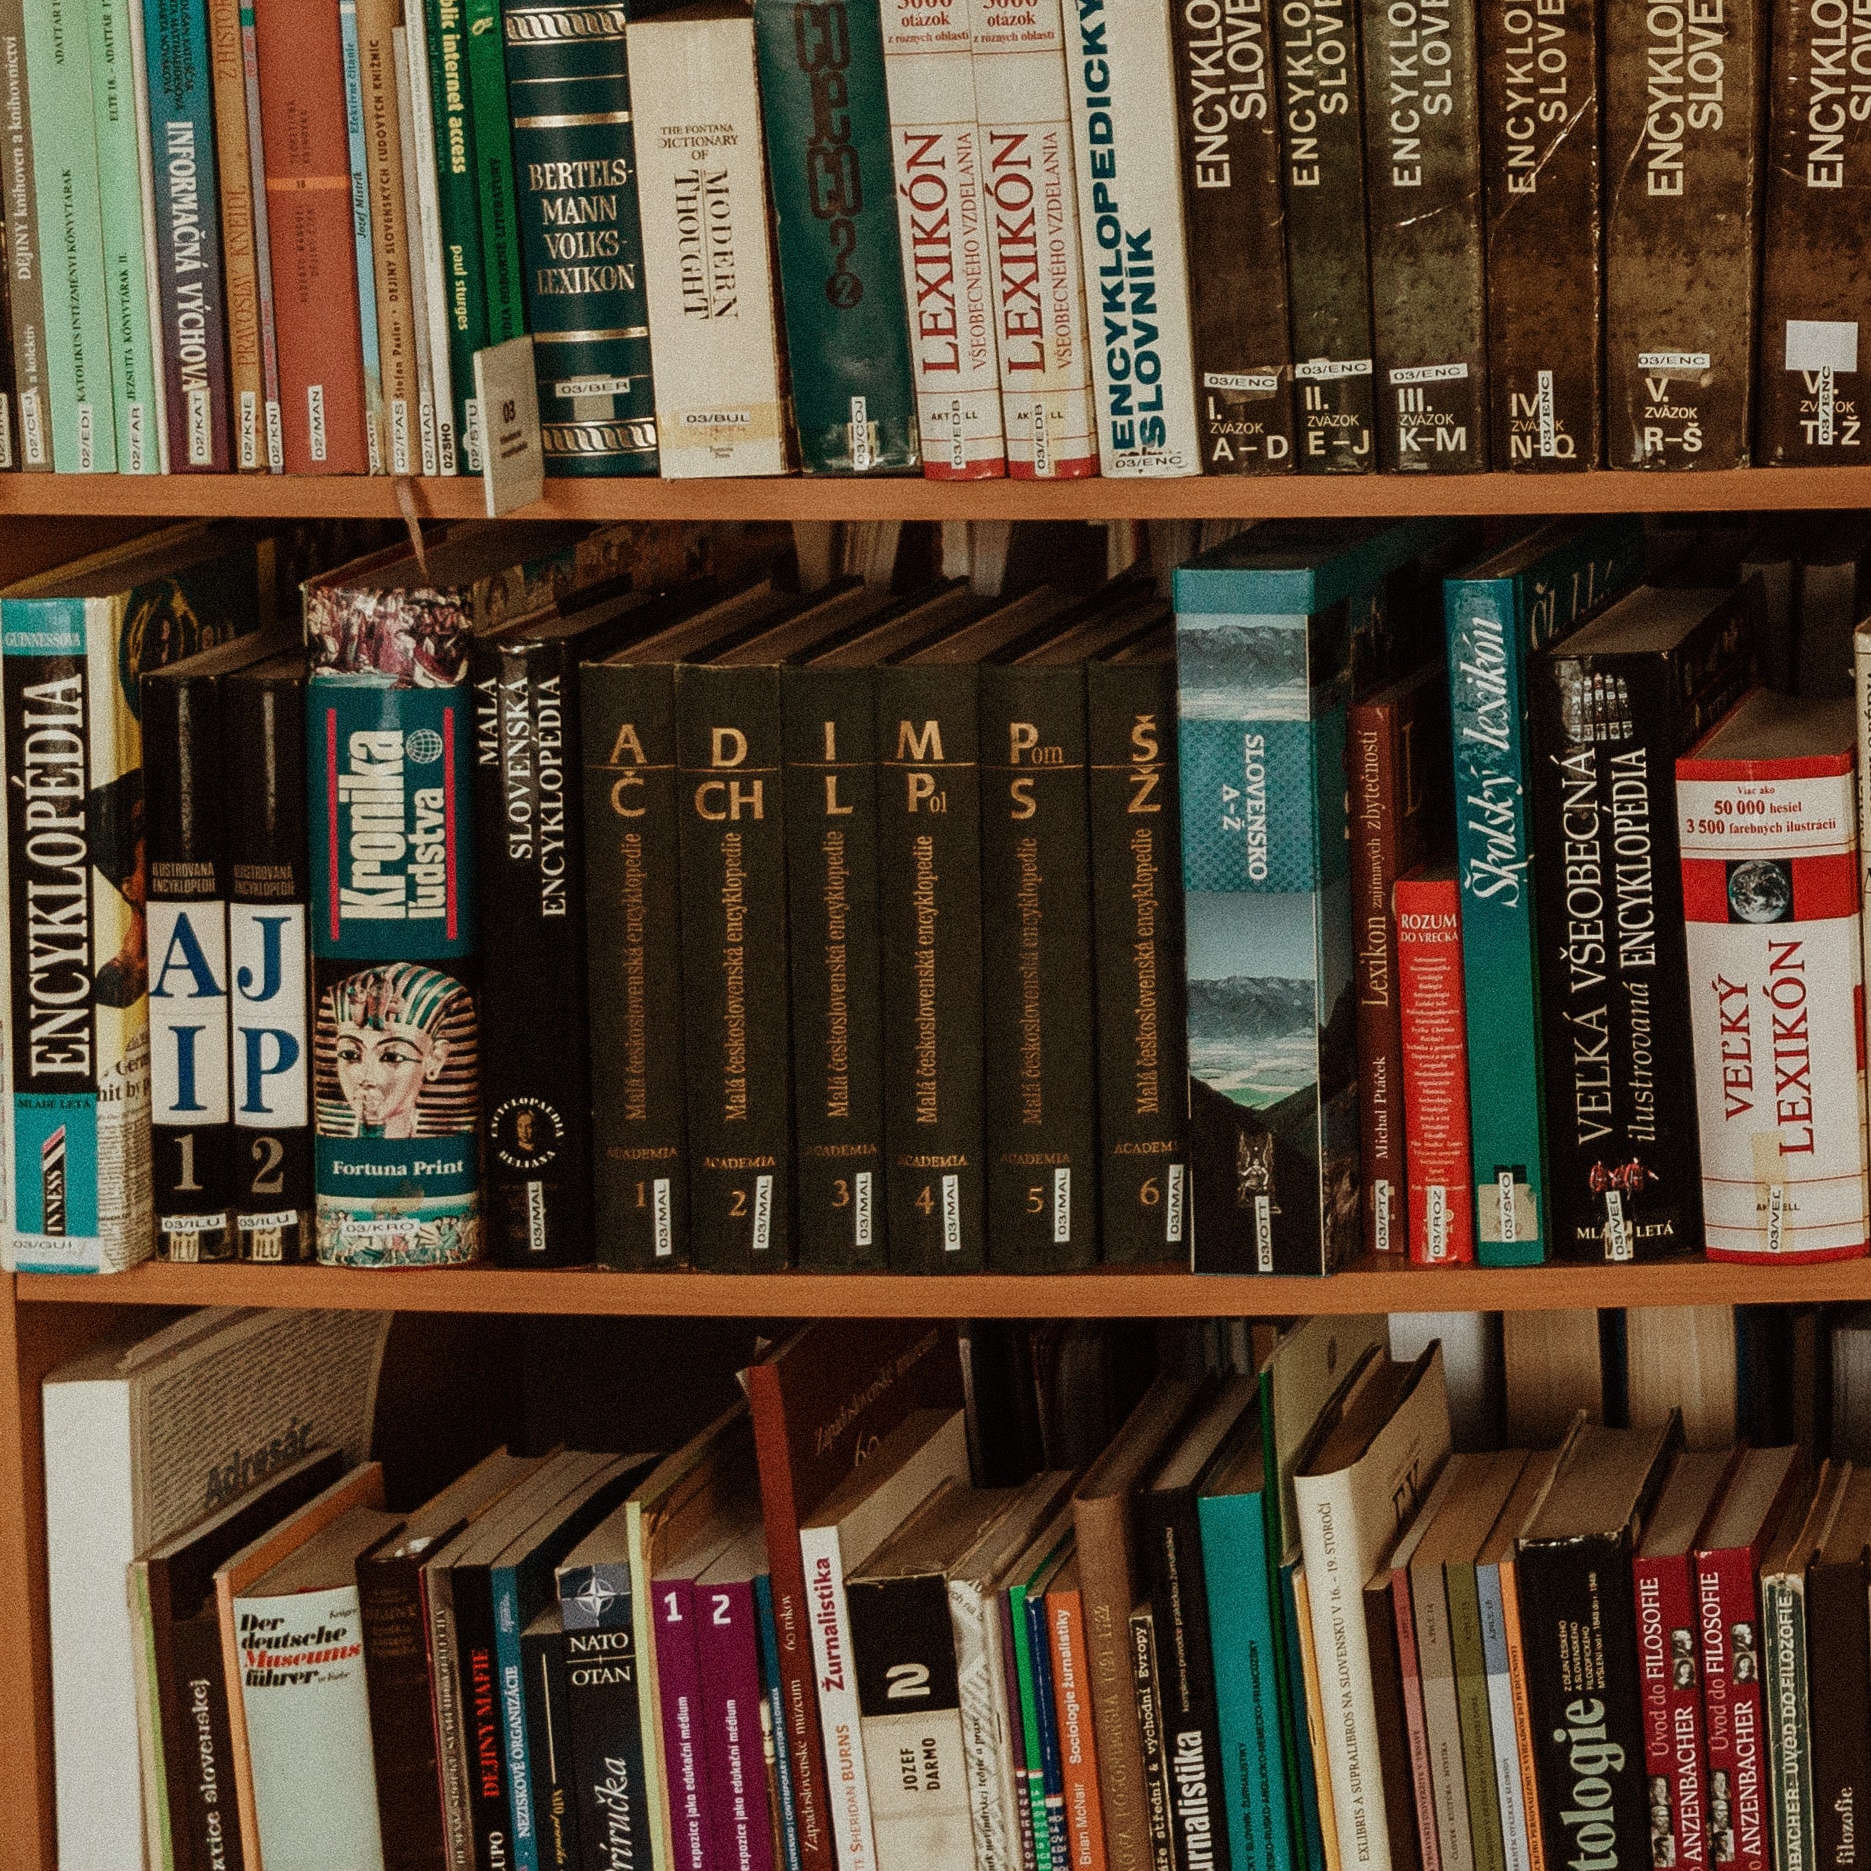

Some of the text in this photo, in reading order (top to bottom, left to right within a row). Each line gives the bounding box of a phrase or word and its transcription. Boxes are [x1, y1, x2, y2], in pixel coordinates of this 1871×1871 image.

[901, 10, 952, 27] otázok
[529, 163, 633, 191] BERTELS-
[542, 197, 617, 223] MANN
[543, 233, 629, 259] VOLKS-
[677, 170, 709, 319] THOUGHT
[701, 170, 738, 320] MODERN
[538, 264, 636, 295] LEXIKON
[1645, 406, 1698, 420] ZVÄZOK
[1244, 733, 1267, 881] SLOVENSKO
[1714, 800, 1802, 816] 50 000 hesiel
[345, 730, 405, 919] Kronika
[10, 674, 90, 1078] ENCYKLOPÉDIA
[1400, 914, 1456, 930] ROZUM
[1400, 931, 1459, 943] DO VRECKA
[1718, 975, 1753, 1120] VEĽKÝ
[1769, 938, 1809, 1156] LEXIKÓN
[176, 1134, 202, 1191] 1
[251, 1138, 283, 1194] 2
[332, 1159, 464, 1176] Fortuna Print
[241, 1614, 283, 1632] Der
[815, 1557, 845, 1693] Žurnalistika
[241, 1626, 346, 1649] deutsche
[569, 1633, 628, 1652] NATO
[245, 1643, 362, 1666] Museums
[245, 1667, 318, 1685] führer
[571, 1665, 630, 1684] OTAN
[903, 1748, 919, 1791] JOZEF
[921, 1736, 940, 1791] DARMO
